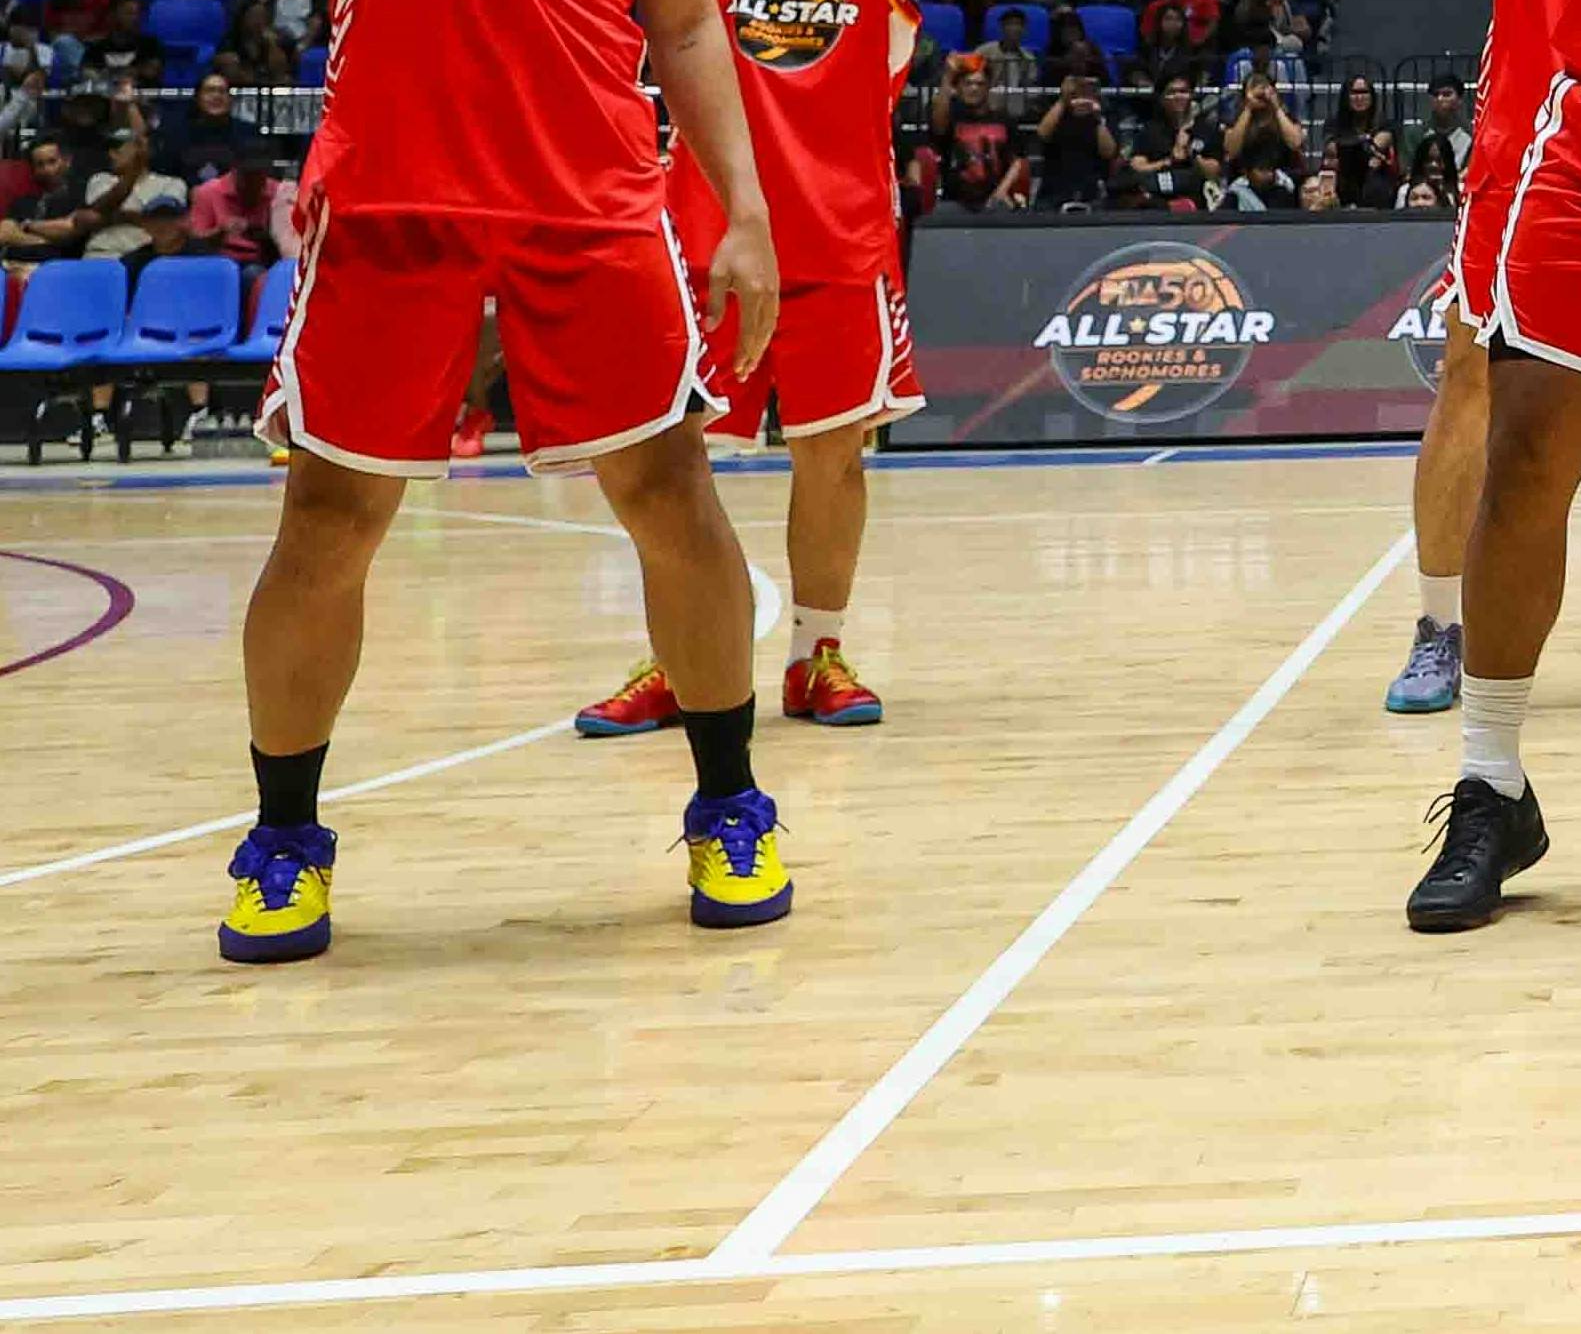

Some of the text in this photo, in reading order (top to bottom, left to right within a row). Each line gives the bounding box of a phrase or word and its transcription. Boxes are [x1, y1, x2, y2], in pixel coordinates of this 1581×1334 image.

[778, 0, 860, 25] STAR
[1033, 310, 1275, 348] ALL STAR
[1097, 349, 1206, 365] ROOKIES &
[1081, 364, 1222, 381] SOPHOMORES
